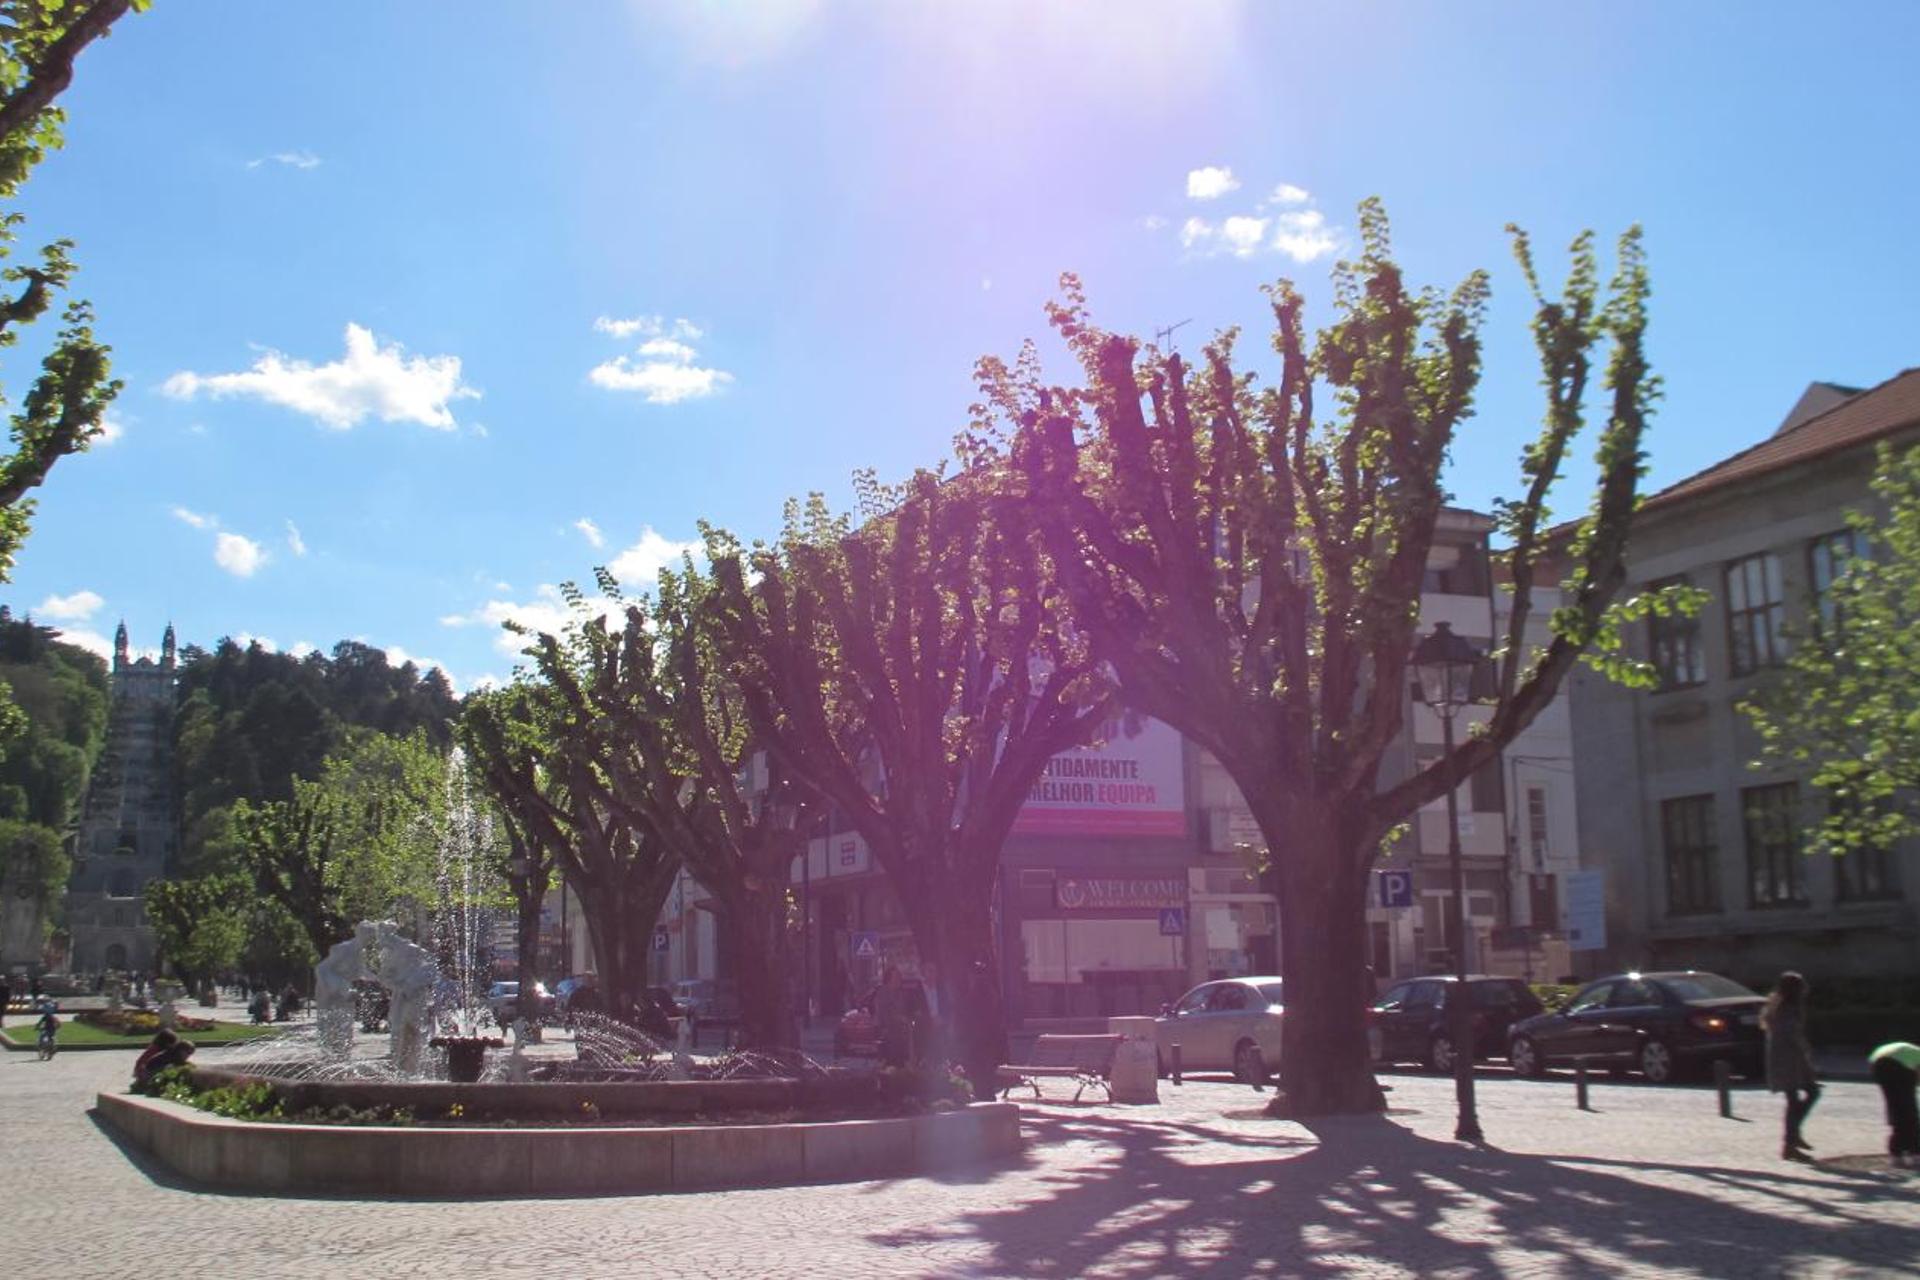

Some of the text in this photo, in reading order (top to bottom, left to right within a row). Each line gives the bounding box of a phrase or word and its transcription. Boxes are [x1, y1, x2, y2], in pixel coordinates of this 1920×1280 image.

[1027, 783, 1157, 804] MELHOR EQUIPA
[1387, 875, 1406, 904] P
[655, 933, 665, 949] P
